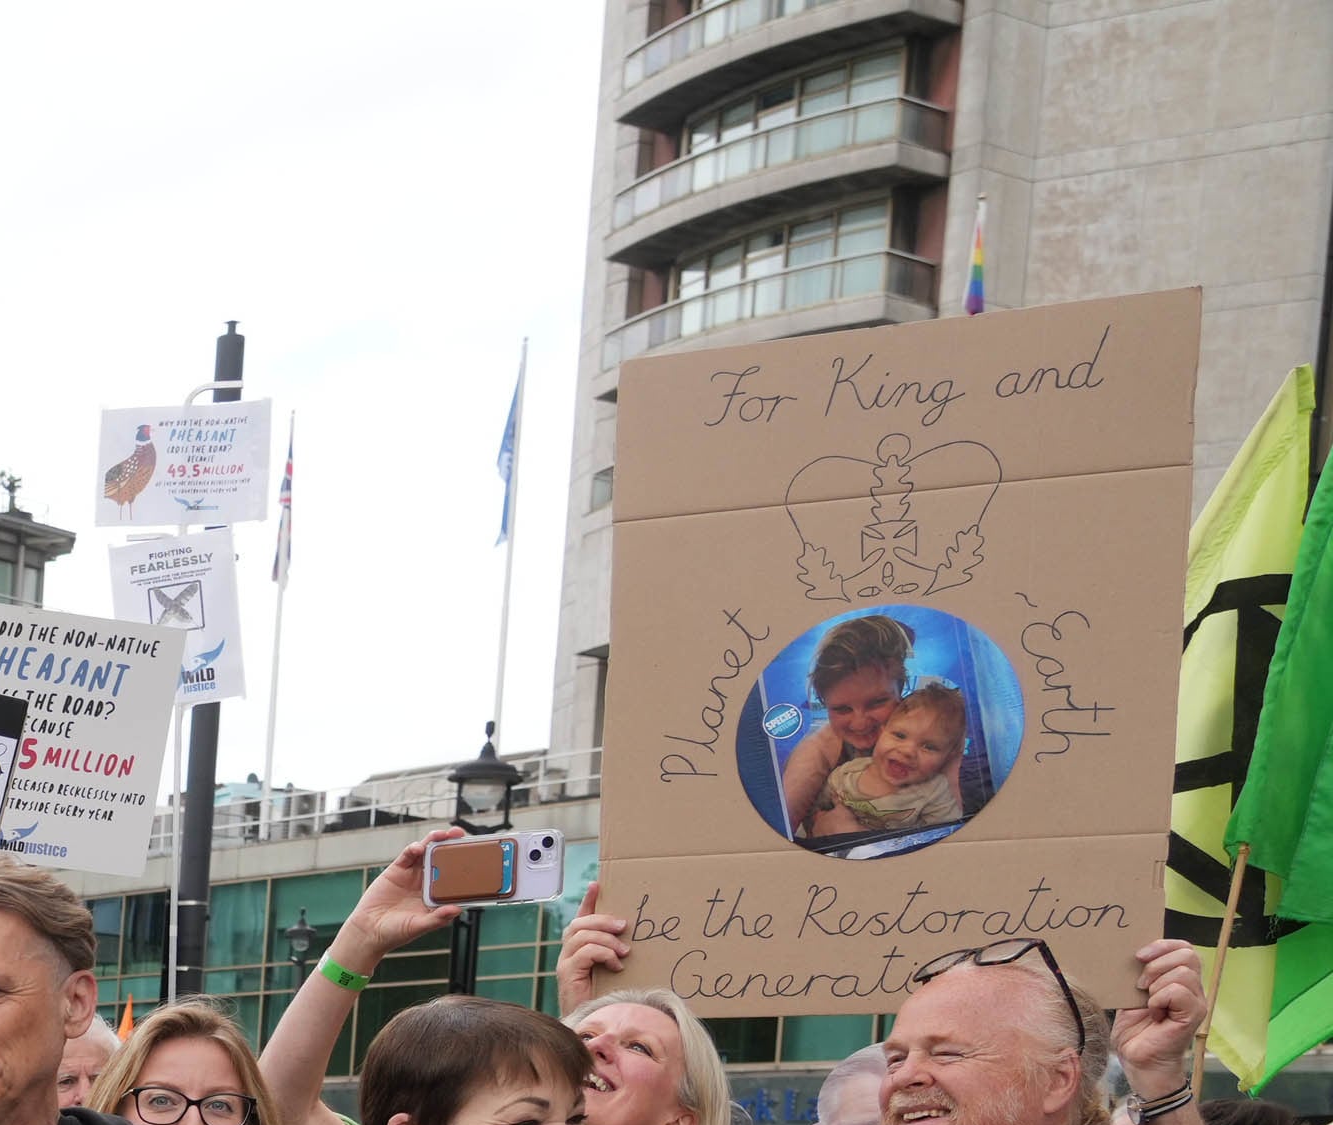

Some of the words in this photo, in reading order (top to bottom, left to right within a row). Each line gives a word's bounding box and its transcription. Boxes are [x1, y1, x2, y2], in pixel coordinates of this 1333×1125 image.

[703, 365, 797, 427] For
[825, 353, 966, 426] King
[995, 324, 1111, 397] and
[169, 428, 237, 442] PHEASANT
[167, 464, 201, 478] 49.5
[202, 464, 244, 476] MILLION
[130, 552, 214, 576] FEARLESSLY
[149, 546, 193, 560] FIGHTING
[28, 624, 58, 644] THE
[63, 628, 161, 658] NON-NATIVE
[25, 689, 58, 713] THE
[62, 694, 116, 720] ROAD?
[660, 607, 770, 783] Planet
[23, 714, 75, 739] CAUSE
[42, 746, 135, 778] MILLION
[11, 777, 54, 794] ELEASED
[57, 783, 117, 803] RECKLESSLY
[120, 792, 146, 806] INTO
[53, 802, 85, 818] EVERY
[88, 808, 114, 822] YEAR
[632, 894, 681, 942] be
[701, 887, 774, 940] the
[798, 877, 1129, 940] Restoration
[670, 945, 920, 1000] Generati
